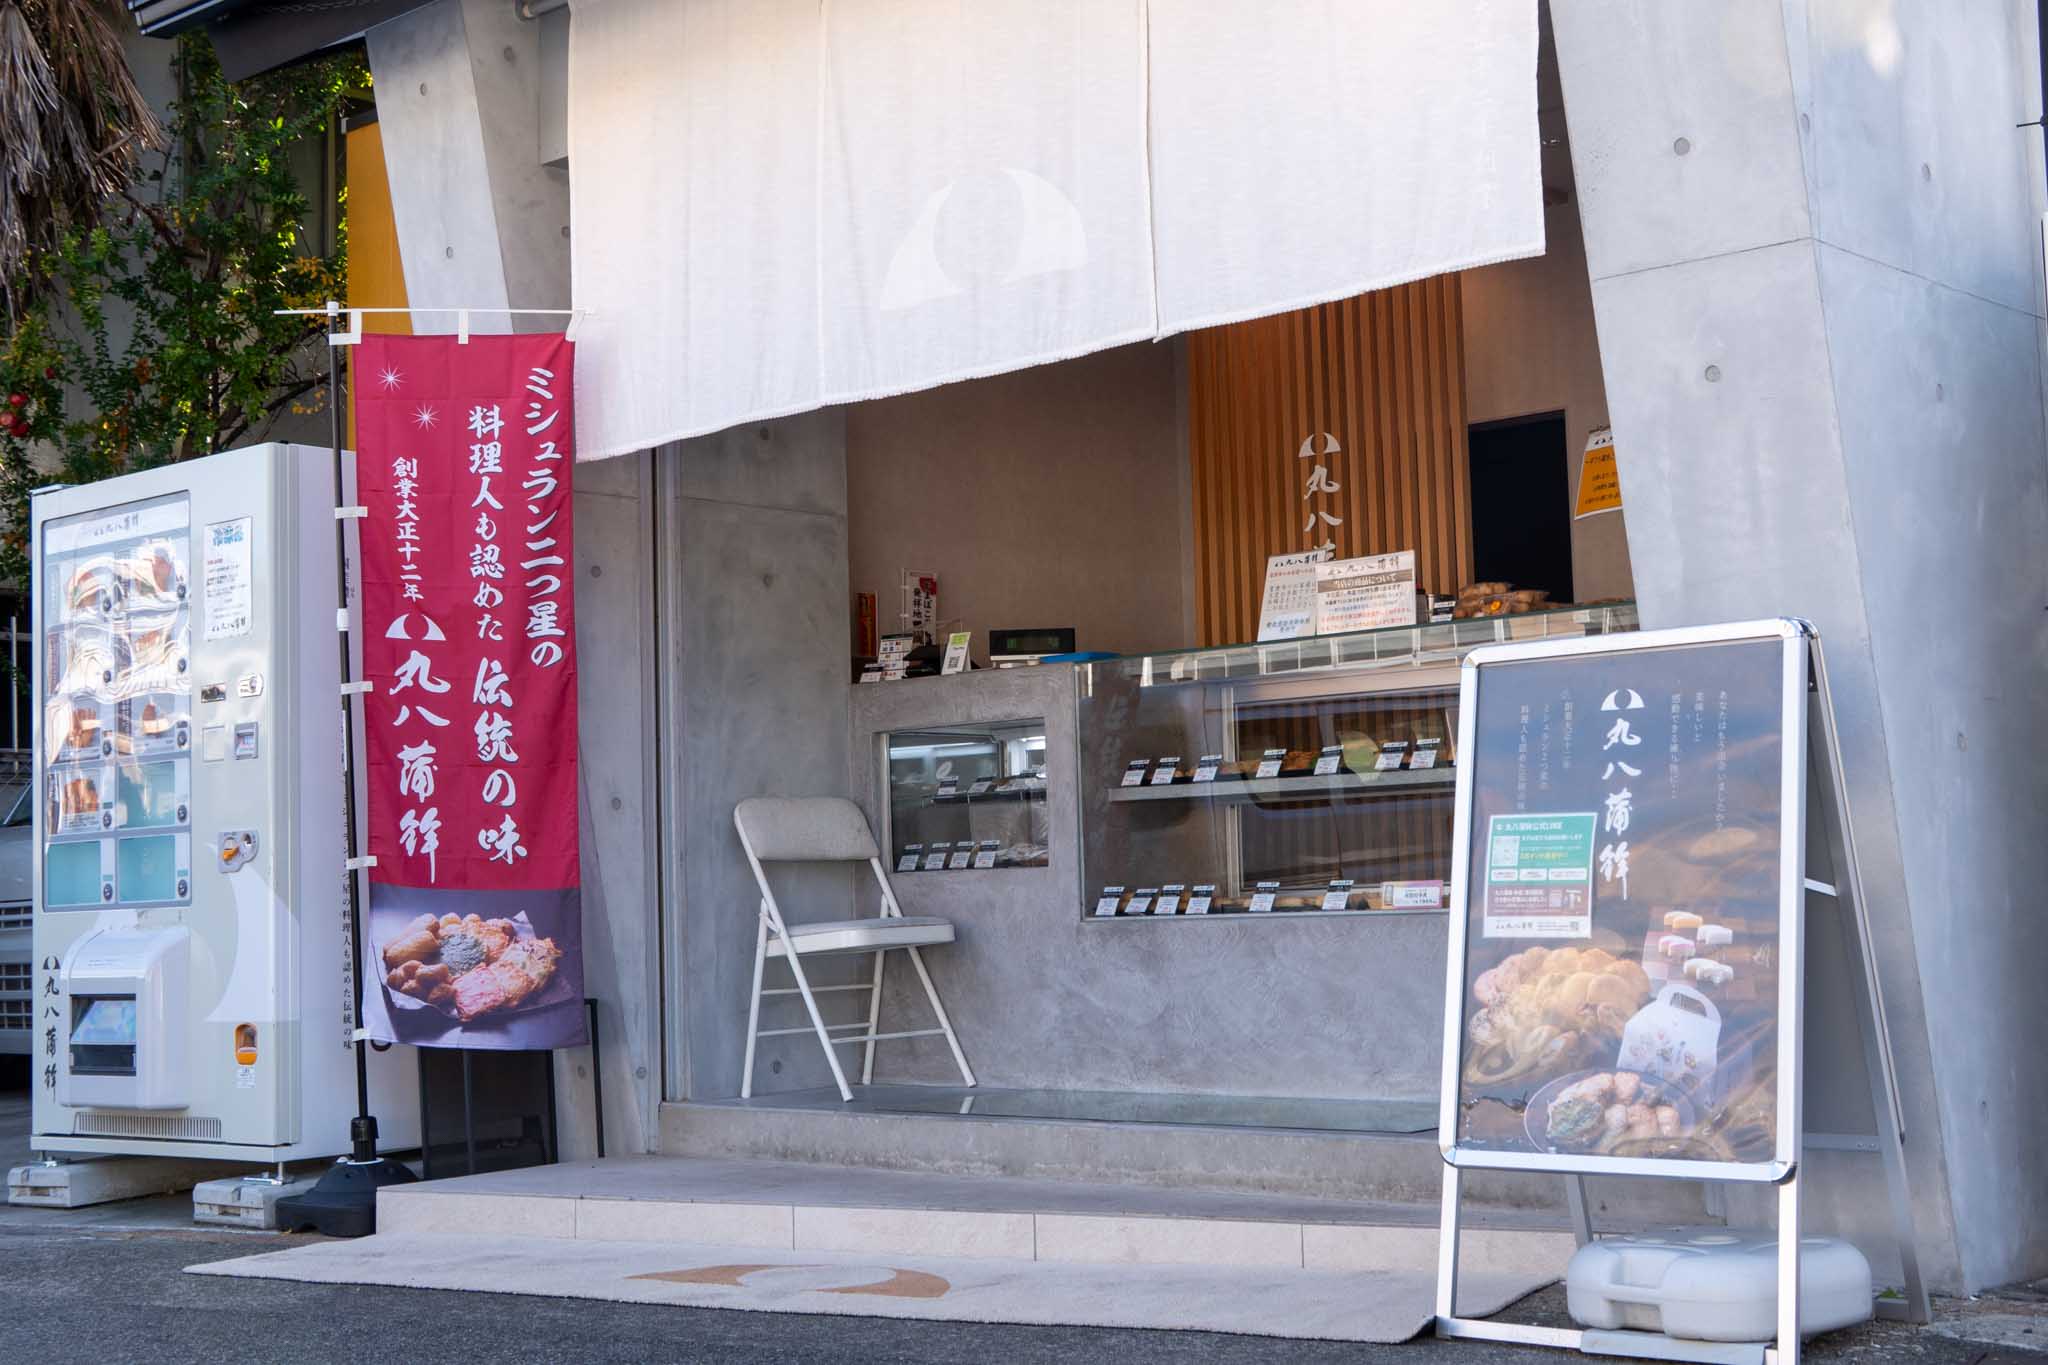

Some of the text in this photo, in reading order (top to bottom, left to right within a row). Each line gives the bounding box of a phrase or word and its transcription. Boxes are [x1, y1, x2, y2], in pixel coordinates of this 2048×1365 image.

[391, 456, 424, 602] 創業大正十二年
[520, 367, 565, 667] ミシュラン二つ星の
[467, 404, 528, 864] 料理人も認めた伝統の味
[388, 650, 451, 884] 丸八蒲鉾
[1600, 717, 1643, 900] 丸八蒲鉾
[43, 975, 60, 1102] 丸八蒲鉾
